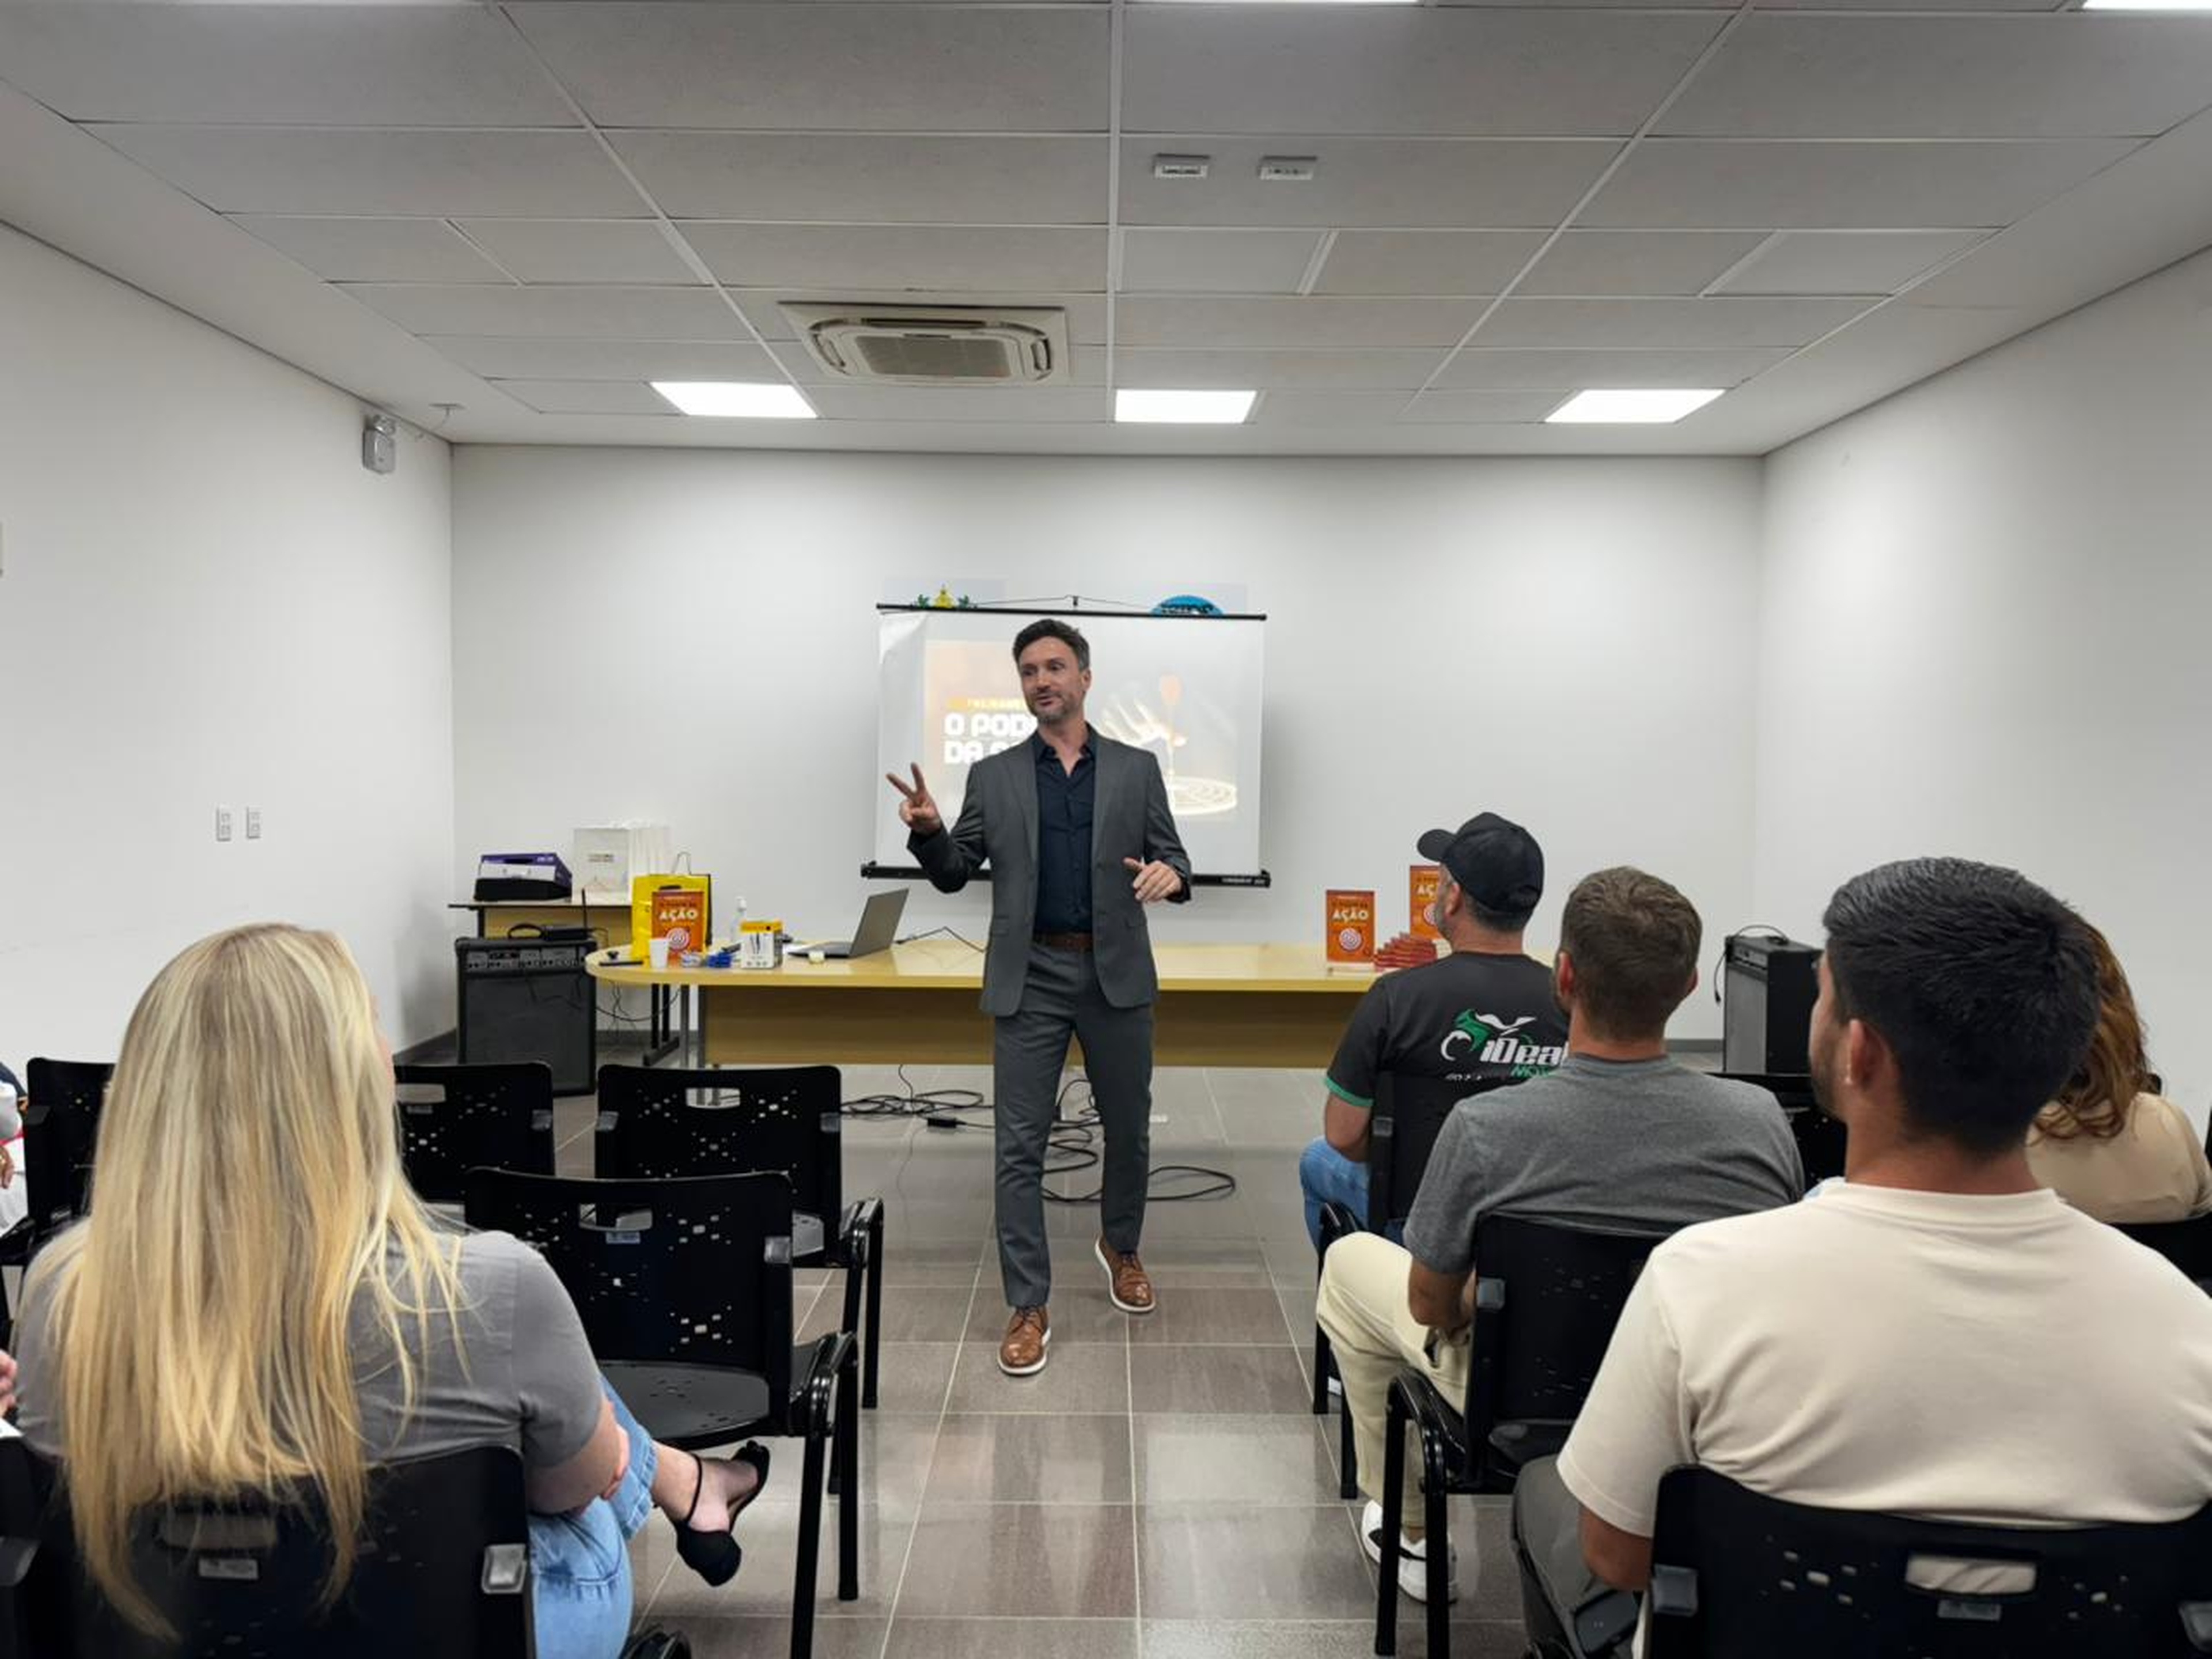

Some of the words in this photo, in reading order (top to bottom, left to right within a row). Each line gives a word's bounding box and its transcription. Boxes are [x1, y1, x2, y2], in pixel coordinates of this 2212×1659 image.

[944, 713, 965, 736] O
[971, 713, 1036, 737] POD
[944, 740, 984, 765] DA
[1418, 884, 1437, 900] AÇ
[660, 907, 698, 922] AÇÃO
[1332, 907, 1369, 923] AÇÃO
